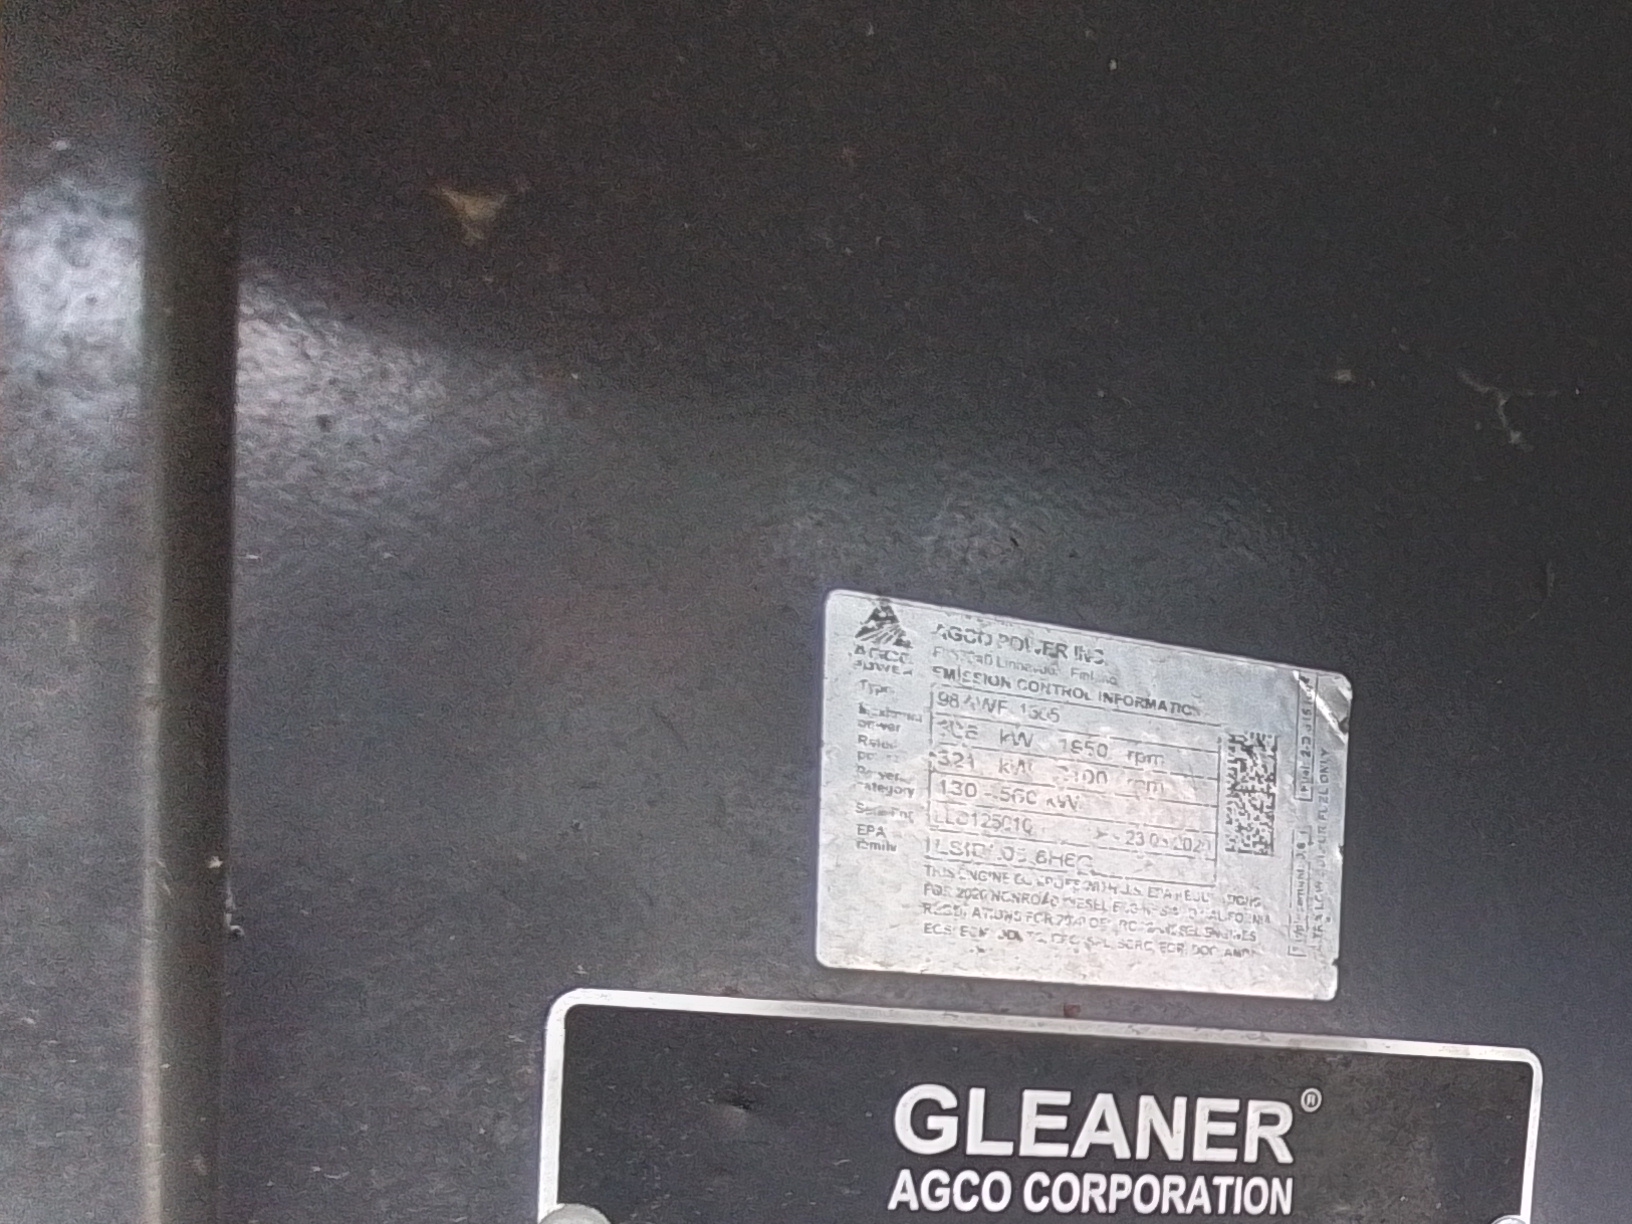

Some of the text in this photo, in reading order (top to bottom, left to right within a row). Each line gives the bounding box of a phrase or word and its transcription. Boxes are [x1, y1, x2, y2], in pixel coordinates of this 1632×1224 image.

[932, 665, 1010, 690] EMISSION
[1017, 678, 1091, 702] CONTROL
[939, 778, 978, 799] 130
[857, 823, 887, 839] EPA
[894, 1083, 1294, 1164] GLEANER
[887, 1168, 1293, 1215] AGCO CORPORATION
